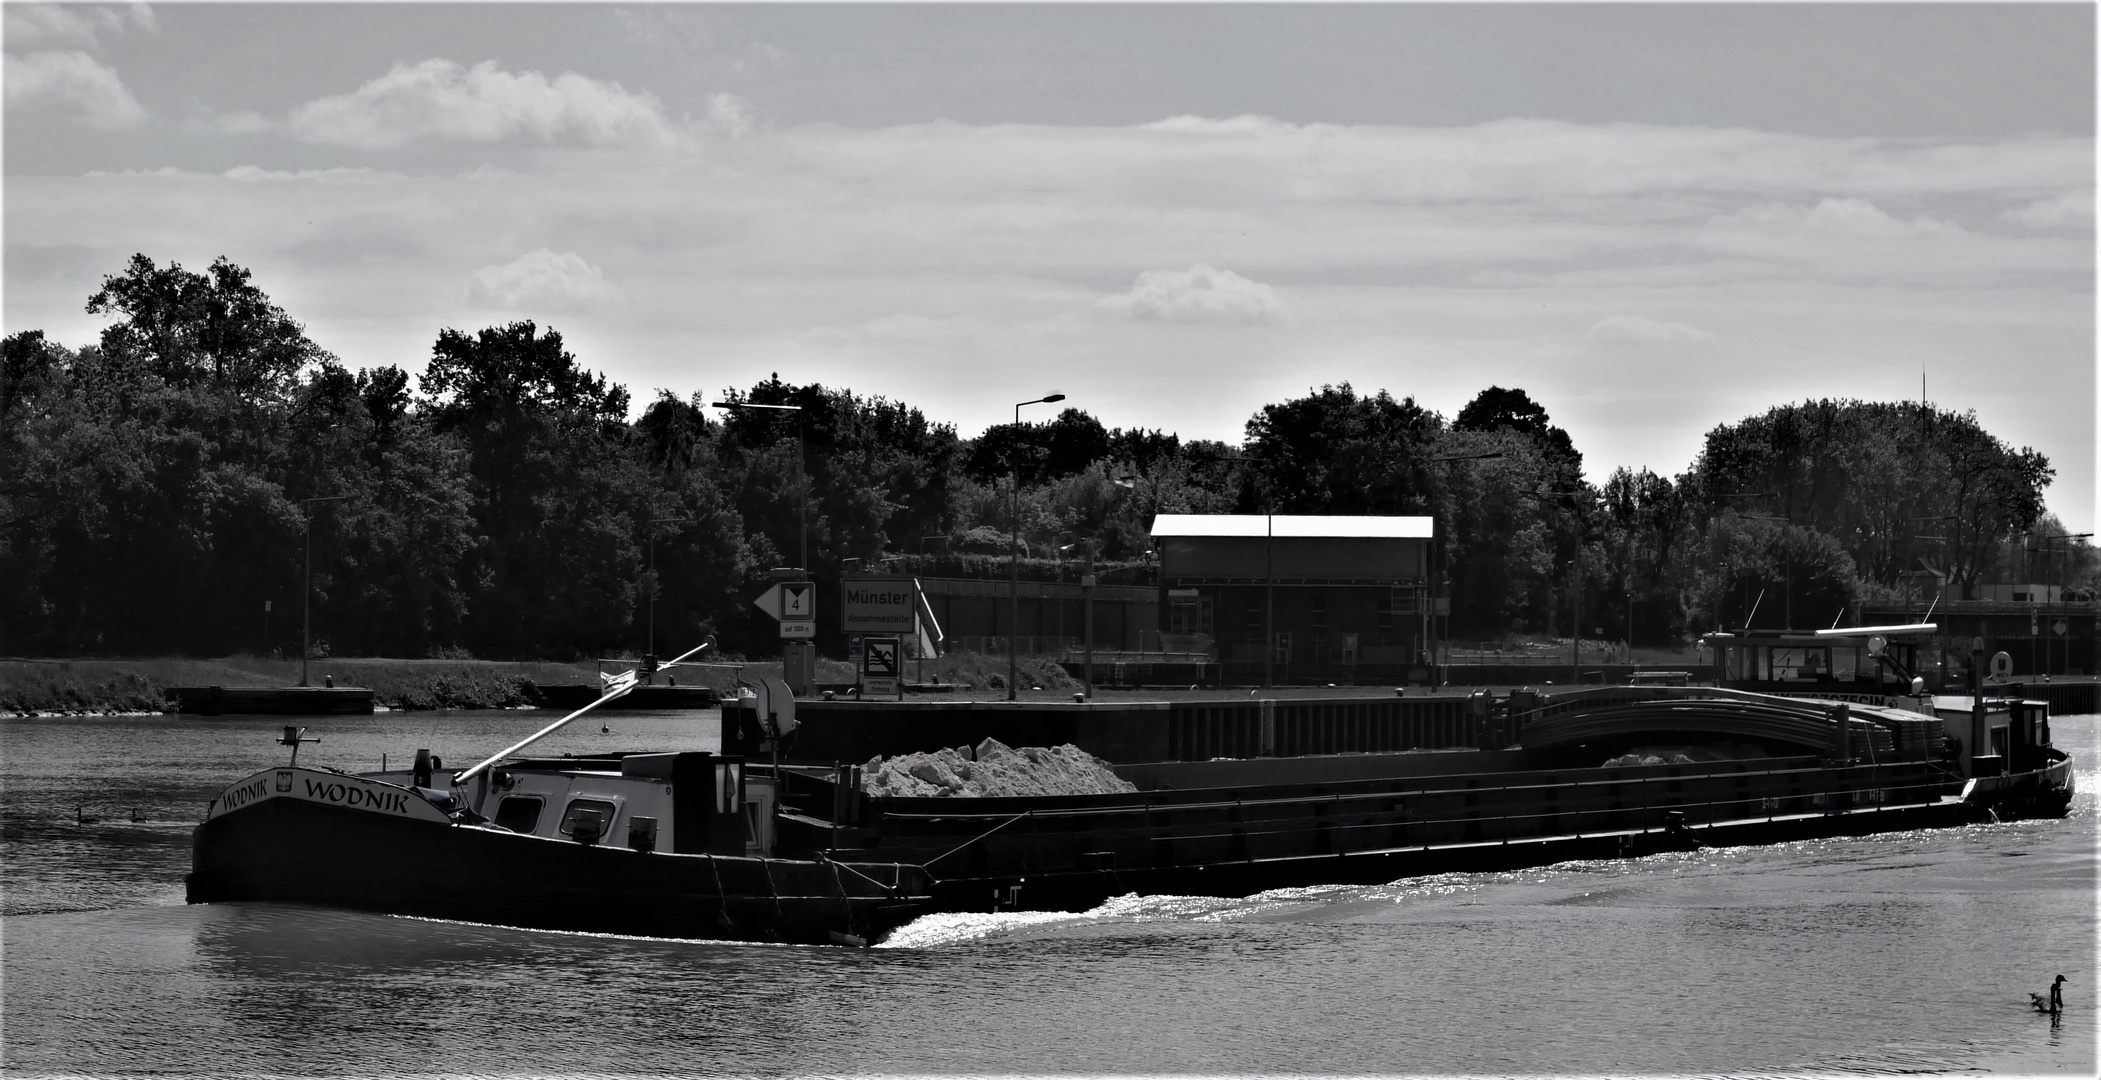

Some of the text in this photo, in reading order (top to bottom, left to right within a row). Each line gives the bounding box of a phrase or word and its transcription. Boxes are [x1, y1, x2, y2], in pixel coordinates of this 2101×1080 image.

[847, 589, 909, 604] Münster
[792, 599, 800, 610] 4
[847, 614, 909, 623] Annahmestelle
[222, 778, 268, 811] WODNIK
[305, 779, 408, 813] WODNIK
